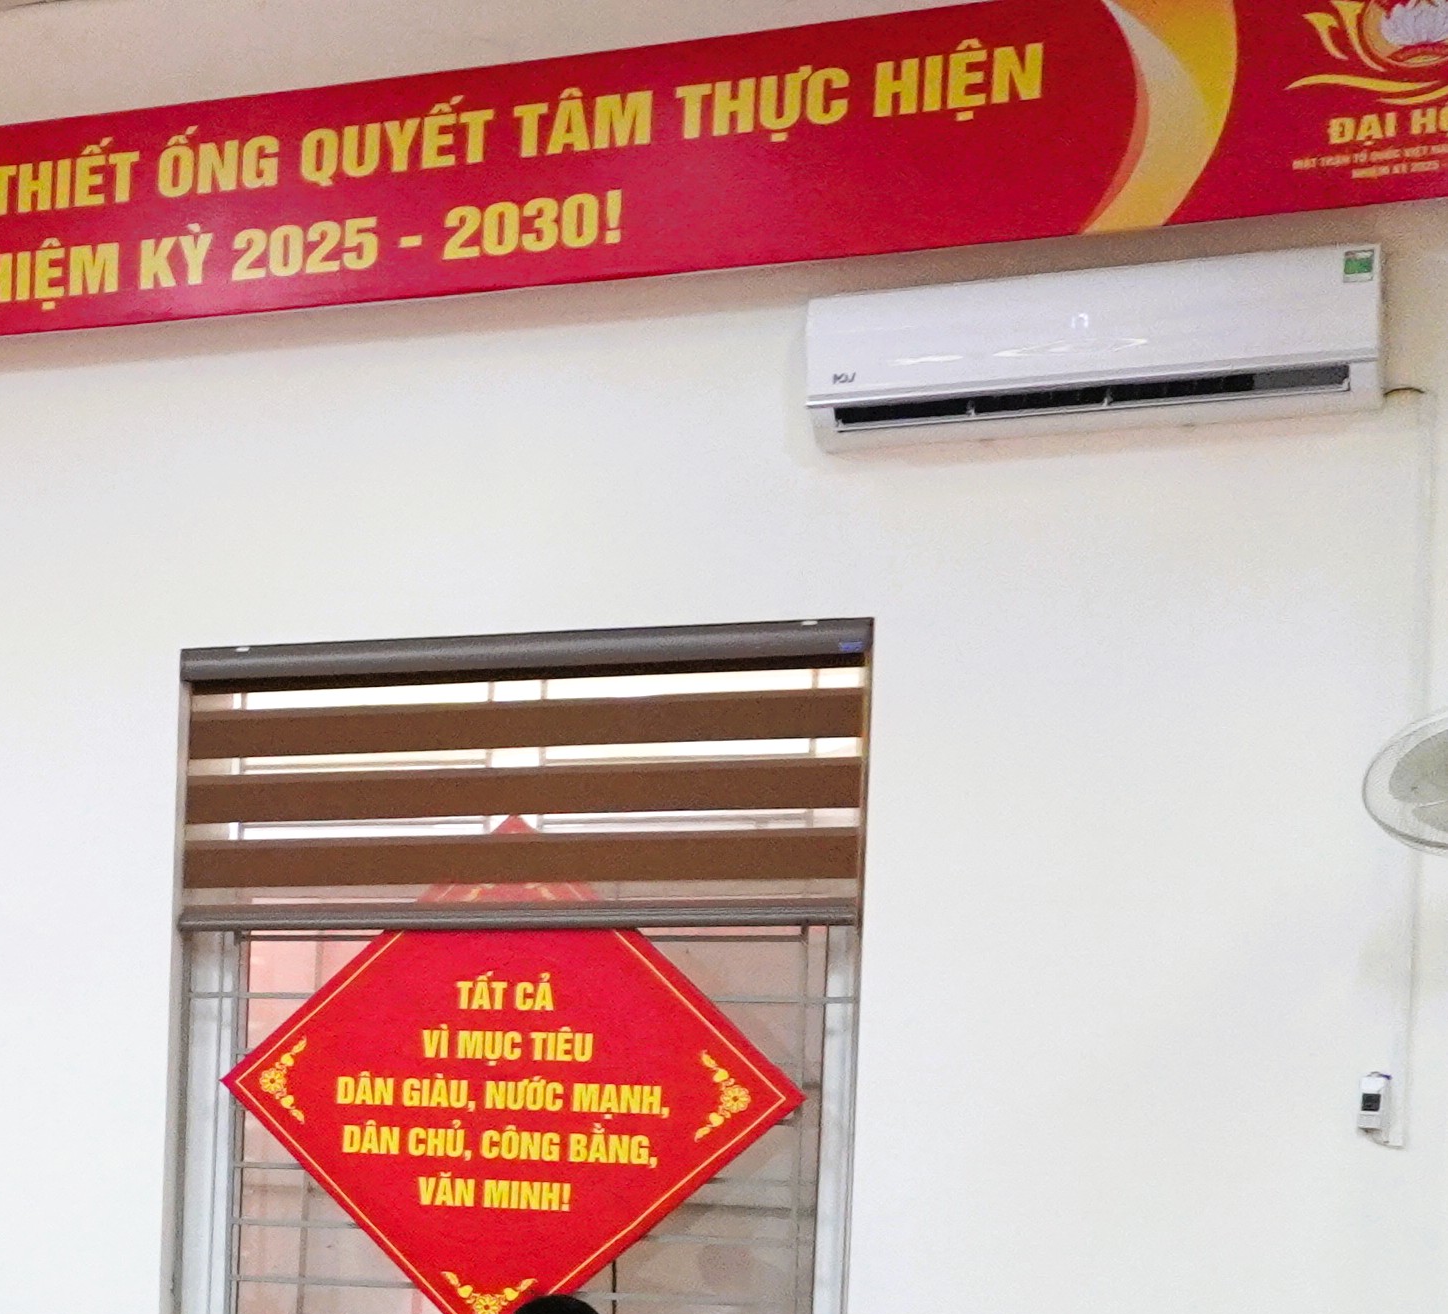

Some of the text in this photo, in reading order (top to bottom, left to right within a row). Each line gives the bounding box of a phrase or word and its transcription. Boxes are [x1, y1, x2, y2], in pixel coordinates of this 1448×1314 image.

[157, 126, 279, 198] ỐNG
[300, 95, 494, 186] QUYẾT
[514, 88, 653, 158] TÂM
[675, 65, 849, 142] THỰC
[874, 39, 1043, 121] HIỆN
[1328, 112, 1397, 146] ĐẠI
[138, 223, 213, 290] KỲ
[230, 217, 378, 283] 2025
[399, 235, 422, 248] -
[441, 189, 622, 260] 2030!
[457, 971, 554, 1012] TẤT CẢ
[422, 1024, 593, 1067] VÌ MỤC TIÊU
[336, 1071, 670, 1120] DÂN GIÀU, NƯỚC MẠNH,
[343, 1119, 658, 1169] DÂN CHỦ, CÔNG BẰNG,
[418, 1173, 571, 1212] VĂN MINH!
